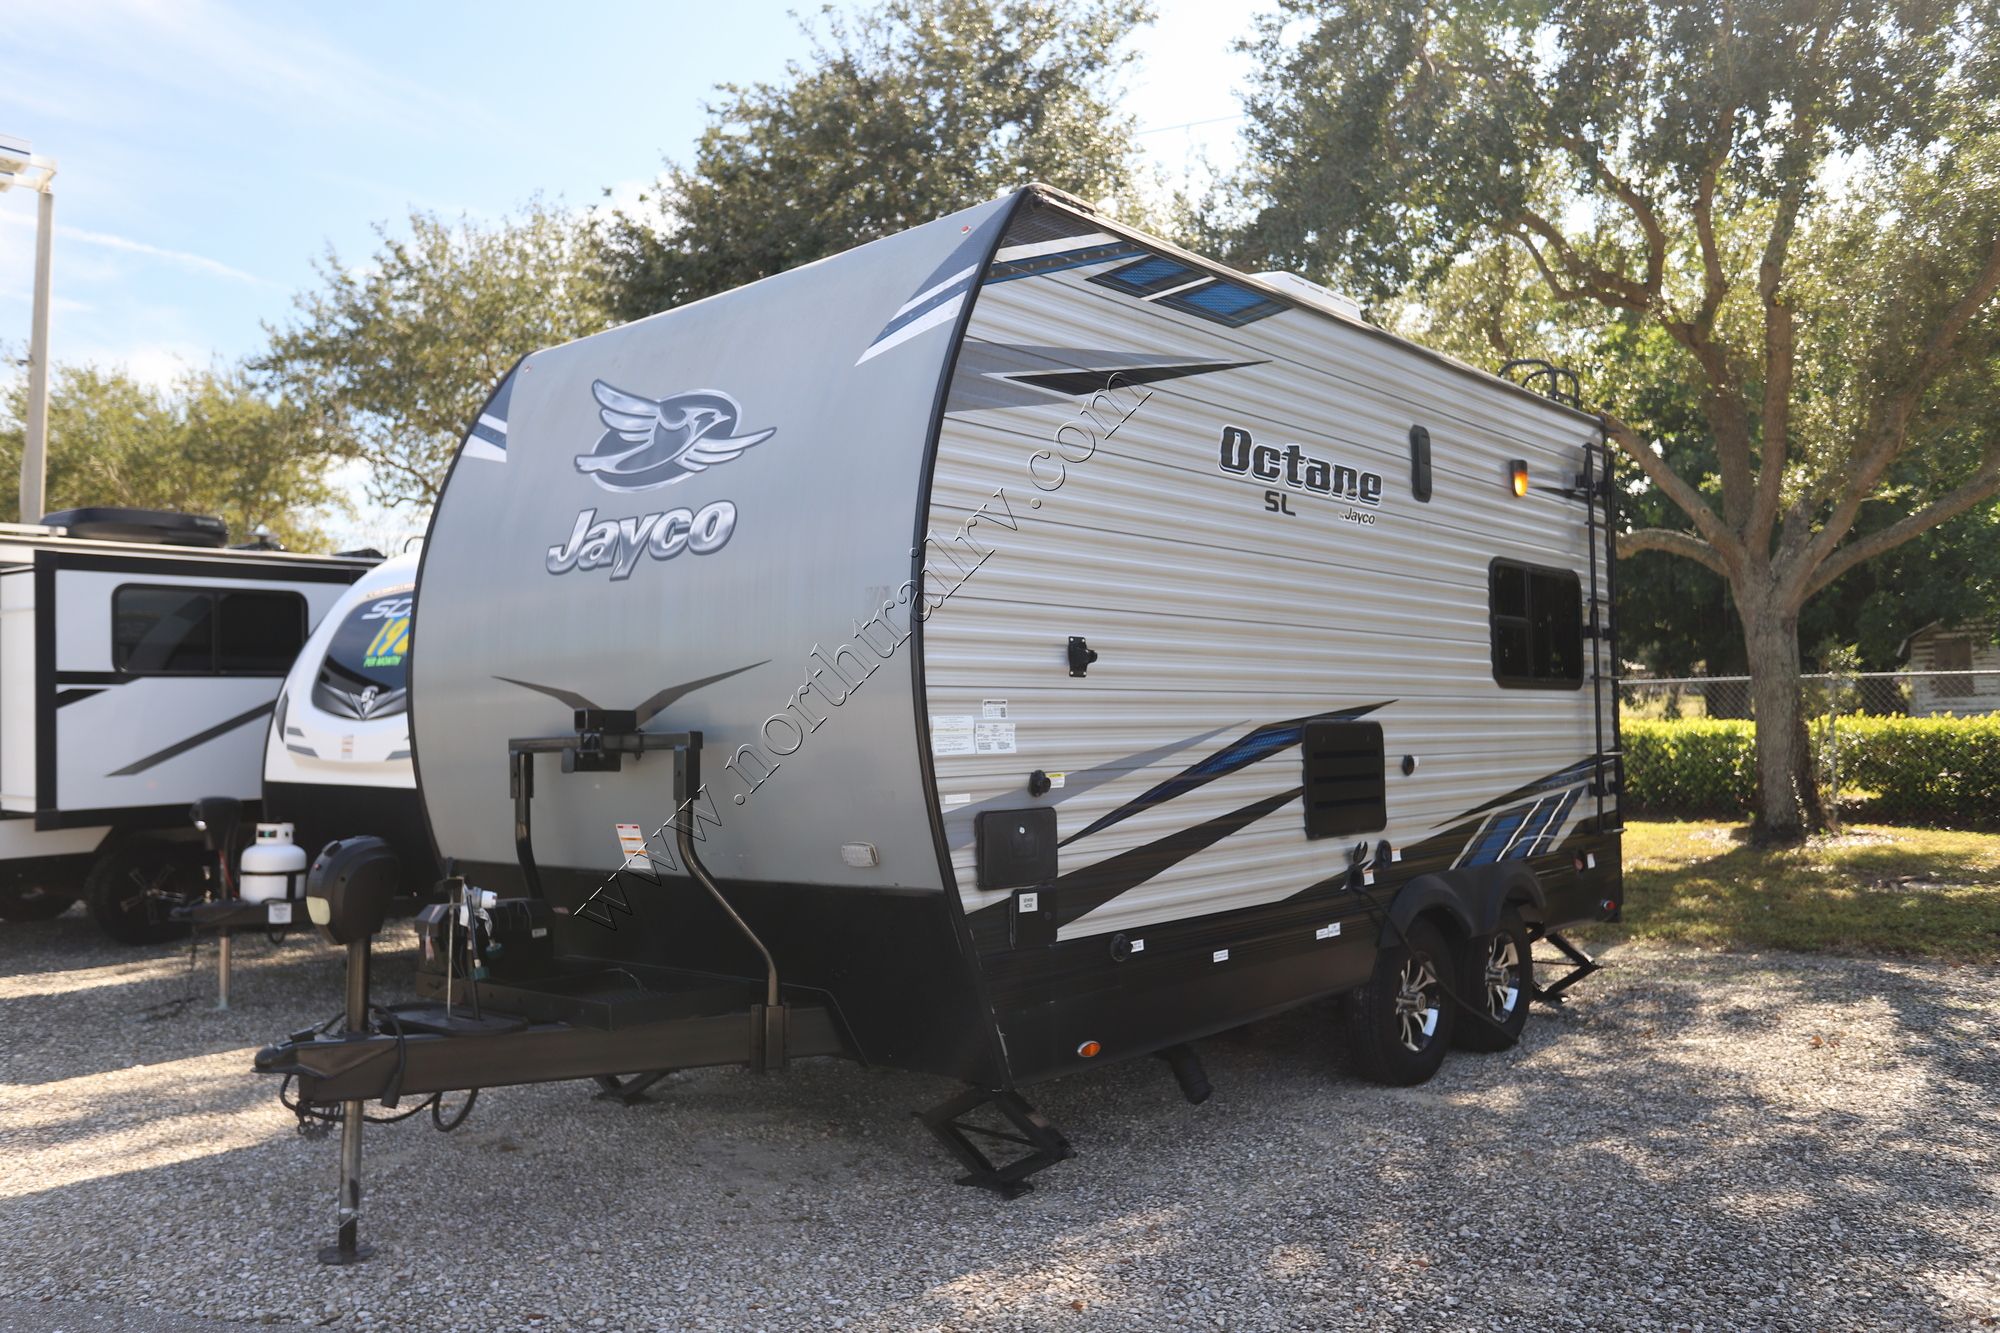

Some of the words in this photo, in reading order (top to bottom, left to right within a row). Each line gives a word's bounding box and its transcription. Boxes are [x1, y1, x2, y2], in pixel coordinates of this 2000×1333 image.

[1219, 425, 1382, 506] Octane
[1264, 490, 1297, 517] SL
[1345, 507, 1376, 524] Jayco
[545, 499, 738, 582] Jayco
